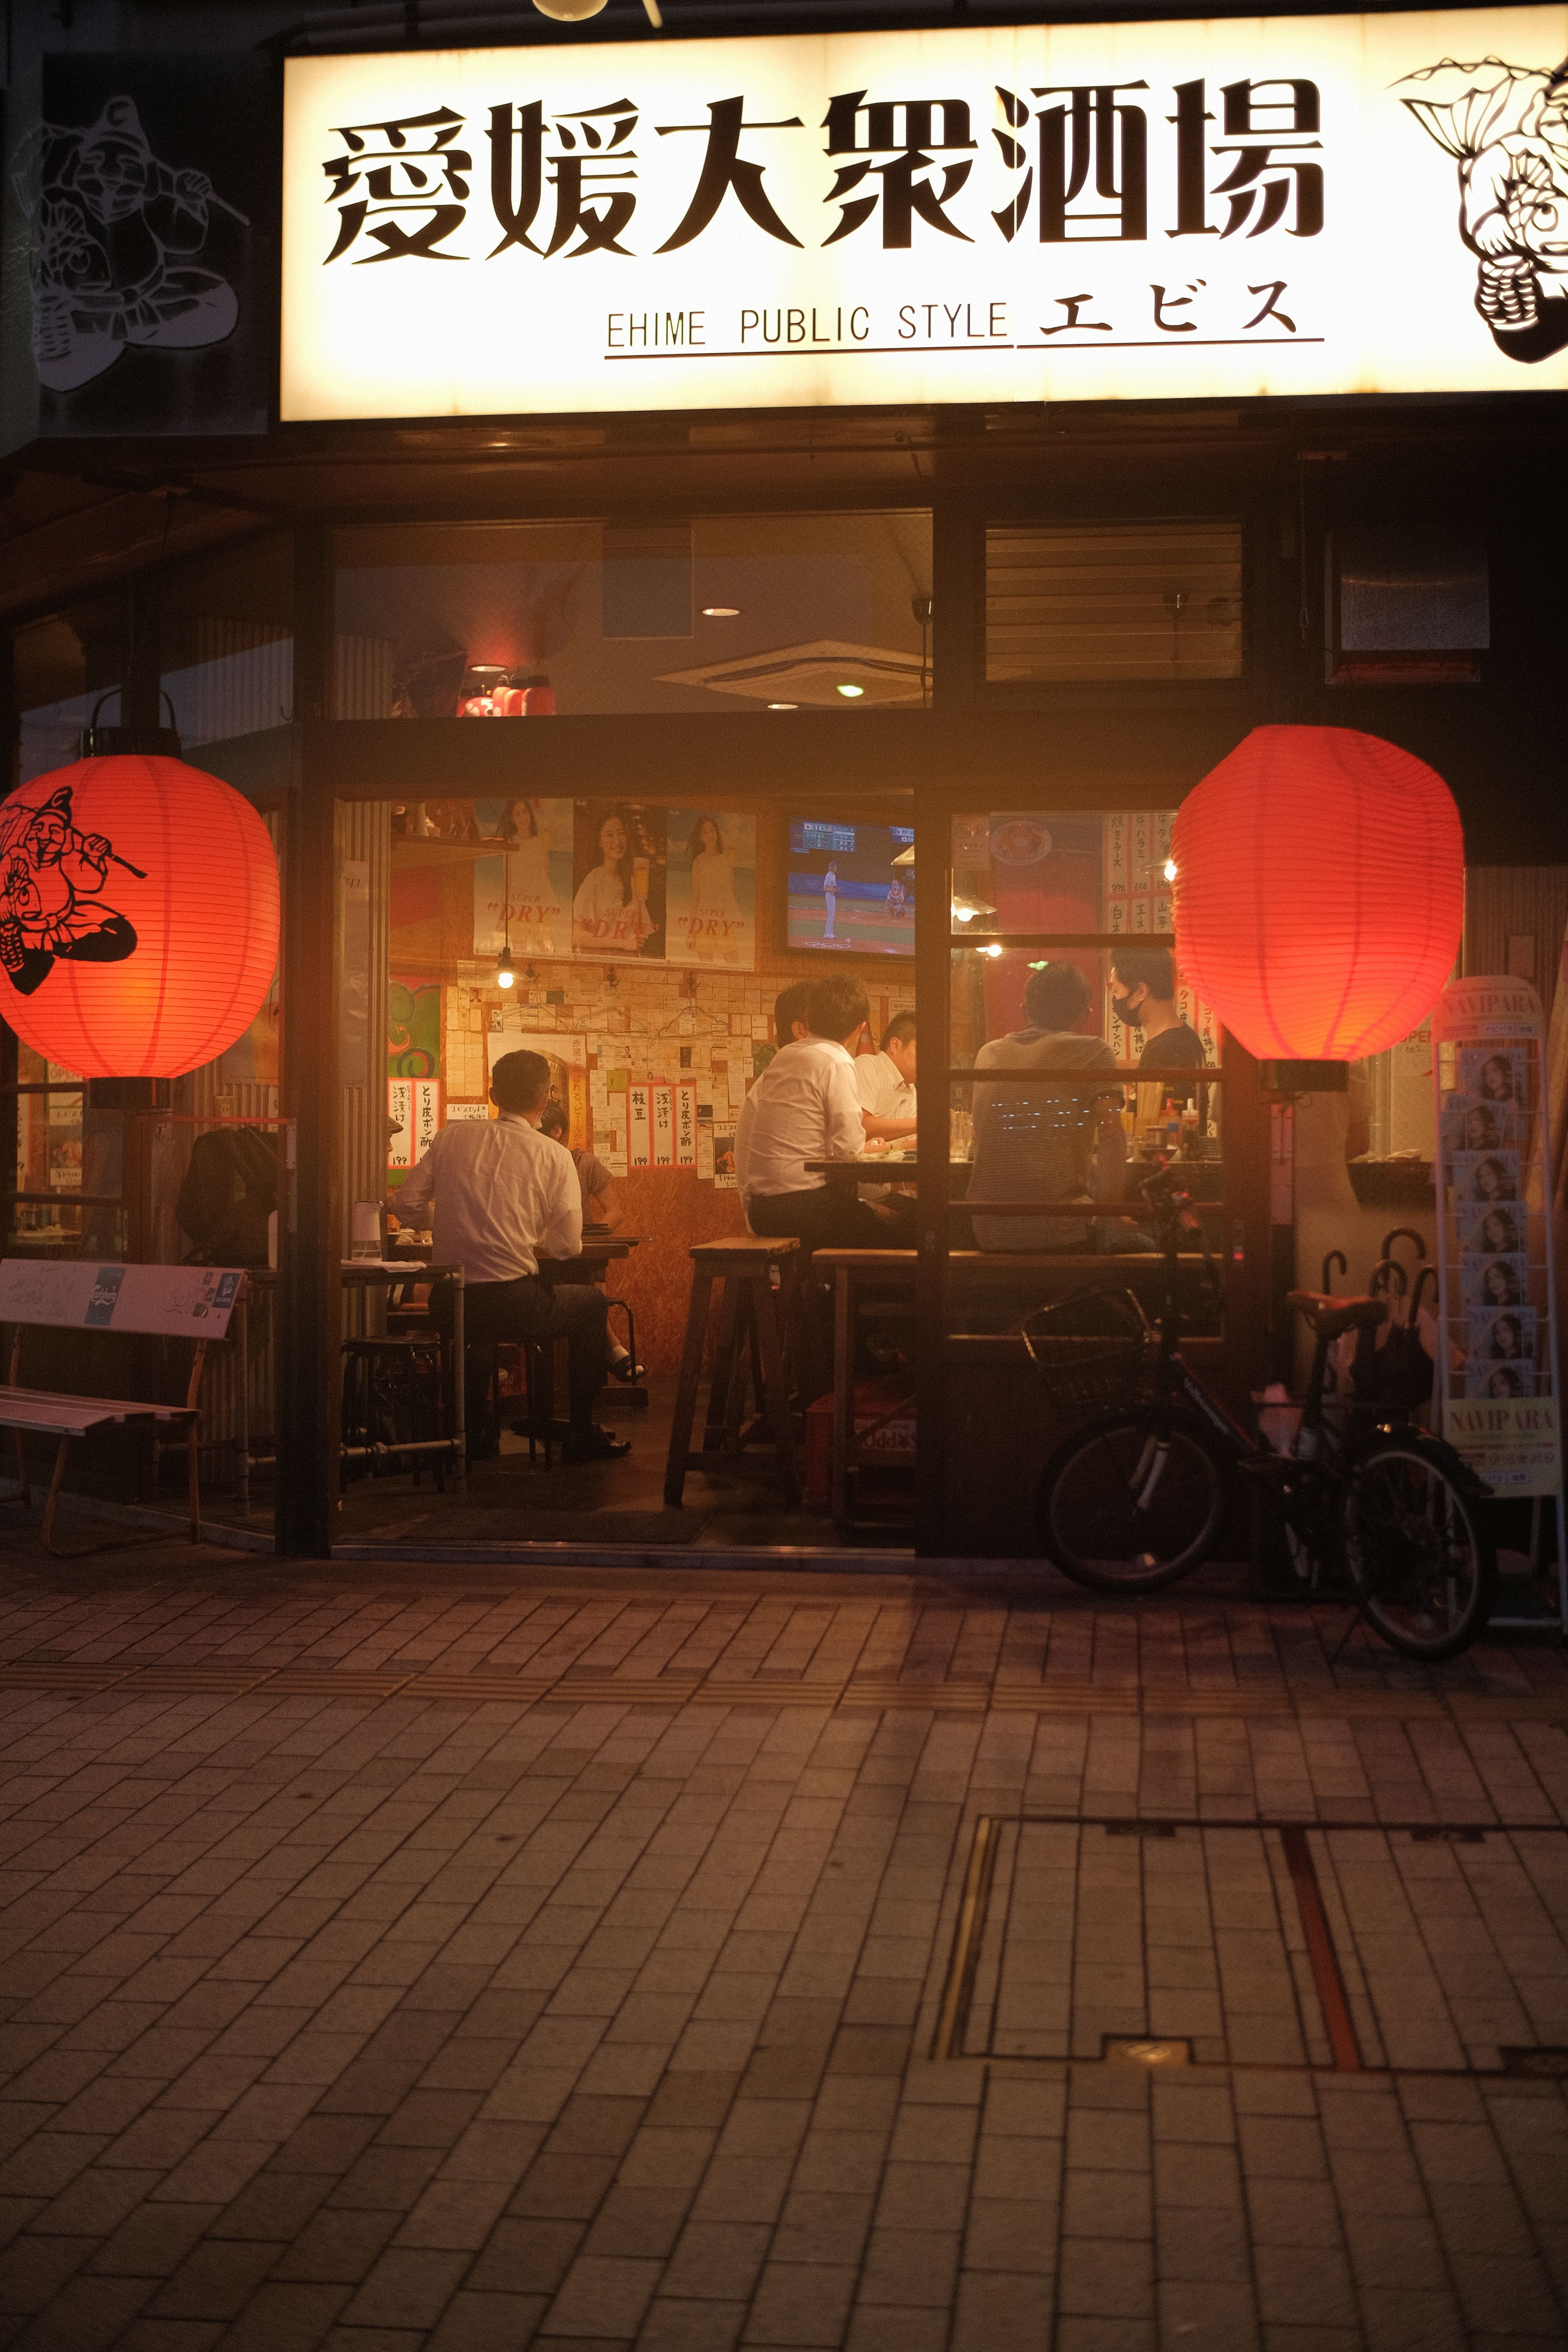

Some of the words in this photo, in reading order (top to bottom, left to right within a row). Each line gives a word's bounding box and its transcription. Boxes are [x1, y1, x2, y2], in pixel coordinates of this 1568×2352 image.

[322, 79, 1323, 264] 愛媛大衆酒場
[1040, 279, 1296, 335] エビス
[608, 311, 705, 347] EHIME
[742, 307, 869, 343] PUBLIC
[898, 303, 1007, 339] STYLE
[510, 894, 541, 903] SUPER
[1134, 883, 1148, 891] 650
[604, 908, 637, 918] SUPER
[699, 908, 725, 917] SUPER
[393, 1086, 406, 1122] 浅漬け
[632, 1090, 646, 1120] 枝豆
[656, 1093, 670, 1128] 浅漬け
[420, 1086, 434, 1147] とり皮ポン酢
[680, 1090, 692, 1147] とり皮ポン酢
[393, 1156, 407, 1165] 199
[634, 1157, 648, 1166] 199
[657, 1157, 670, 1165] 199
[92, 1285, 117, 1302] Carlsberg
